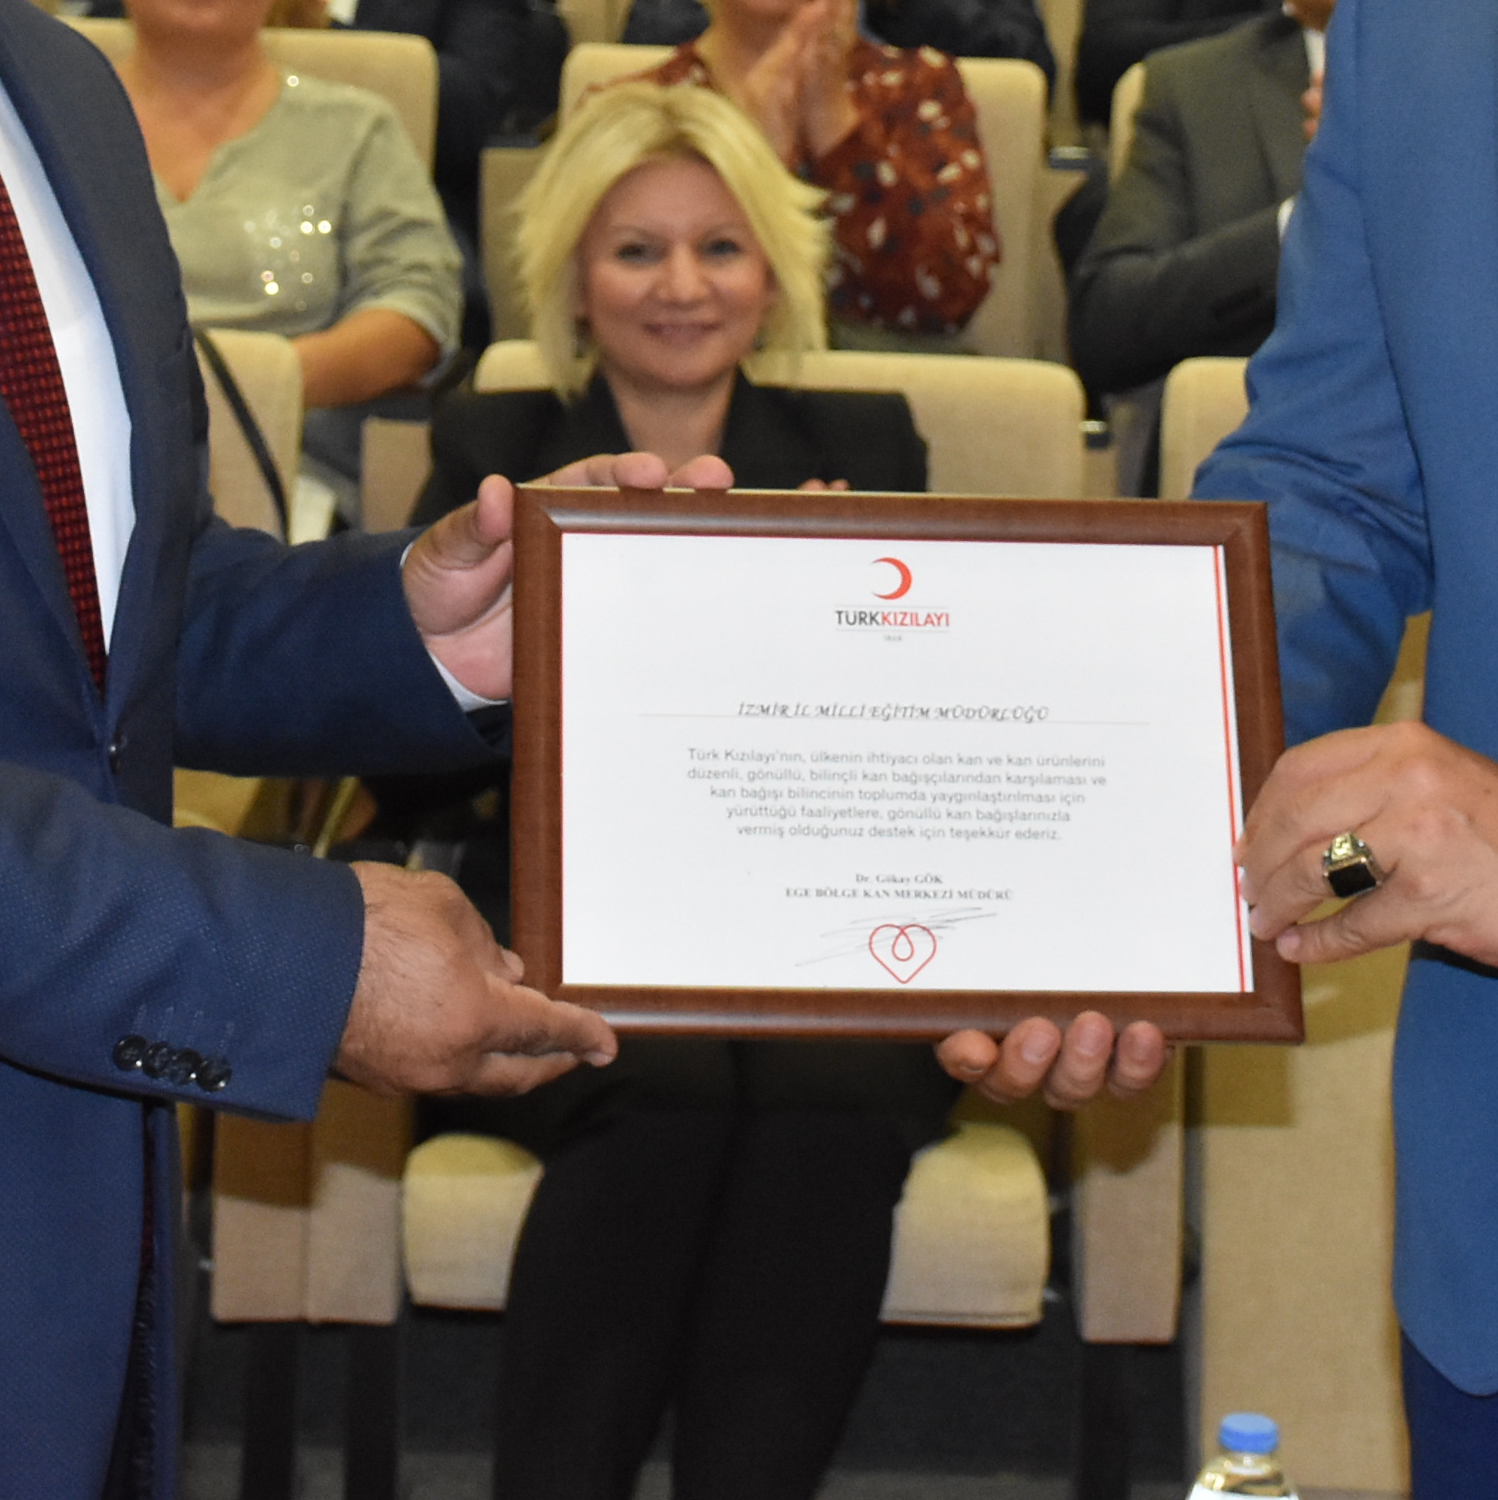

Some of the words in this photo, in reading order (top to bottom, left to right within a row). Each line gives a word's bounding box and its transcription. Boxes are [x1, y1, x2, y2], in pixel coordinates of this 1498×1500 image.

[737, 702, 793, 717] İZMİR
[795, 703, 811, 717] İL
[815, 703, 866, 718] MİLLİ
[869, 704, 931, 721] EĞİTİM
[934, 706, 1049, 724] MÜDÜRLÜĞÜ
[688, 748, 719, 761] Türk
[810, 750, 862, 763] ülkenin
[867, 752, 918, 766] ihtiyacı
[922, 753, 953, 765] olan
[957, 753, 982, 765] kan
[987, 756, 1002, 765] ve
[1007, 754, 1032, 766] kan
[1037, 755, 1105, 767] ürünlerini
[810, 770, 857, 784] bilinçli
[862, 771, 887, 782] kan
[892, 771, 1001, 786] bağışçılarından
[1006, 773, 1086, 787] karşılaması
[1092, 777, 1106, 786] ve
[710, 786, 736, 798] kan
[741, 787, 782, 801] bağışı
[788, 788, 853, 800] bilincinin
[859, 788, 926, 802] toplumda
[1061, 792, 1086, 805] için
[727, 806, 795, 820] yürüttüğü
[888, 808, 941, 821] gönüllü
[947, 809, 971, 819] kan
[976, 809, 1071, 823] bağışlarınızla
[737, 826, 784, 839] vermiş
[789, 825, 864, 839] olduğunuz
[868, 826, 915, 838] destek
[920, 828, 945, 841] için
[950, 827, 1010, 842] teşekkür
[786, 888, 810, 897] EGE
[815, 887, 857, 898] BÖLGE
[863, 890, 890, 898] KAN
[894, 890, 953, 899] MERKEZİ
